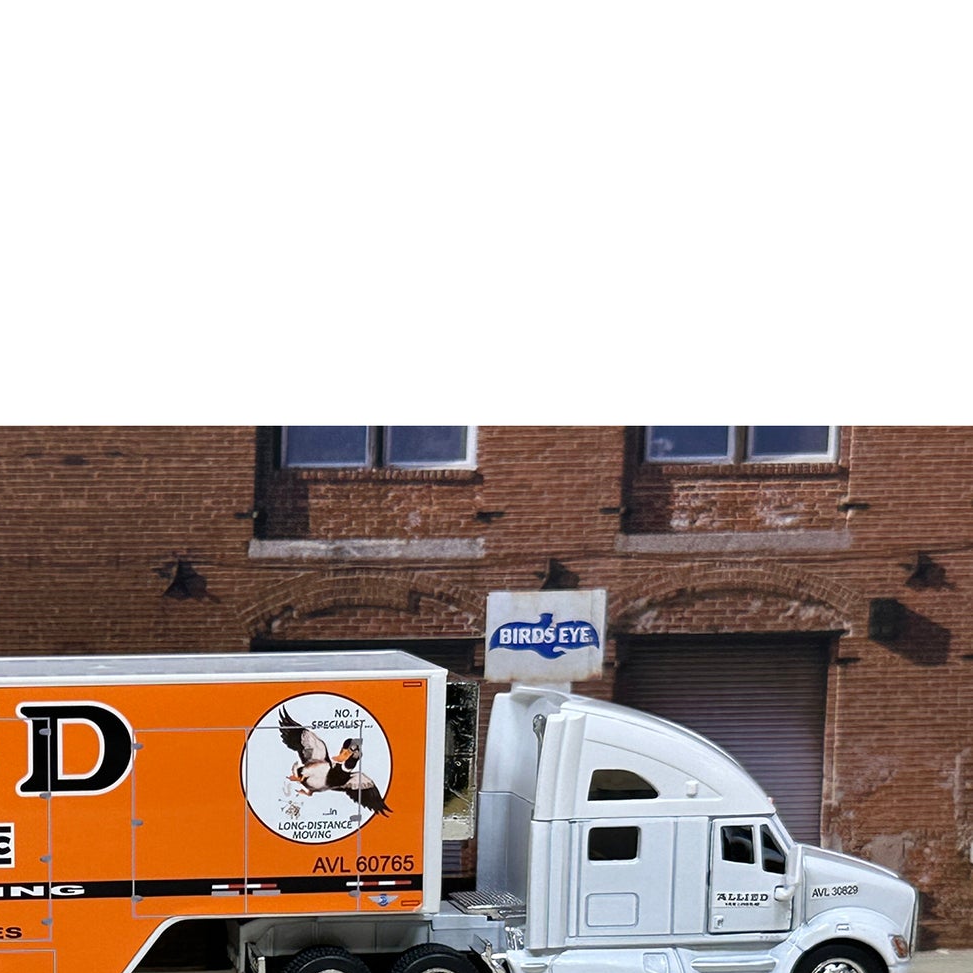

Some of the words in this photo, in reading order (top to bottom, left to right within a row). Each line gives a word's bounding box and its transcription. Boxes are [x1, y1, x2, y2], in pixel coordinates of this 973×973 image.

[558, 626, 591, 644] EYE
[334, 708, 353, 718] NO.
[278, 820, 353, 831] LONG-DISTANCE
[292, 830, 332, 840] MOVING
[312, 856, 351, 874] AVL
[355, 854, 415, 873] 60765
[716, 893, 769, 901] ALLIED
[811, 886, 830, 898] AVL
